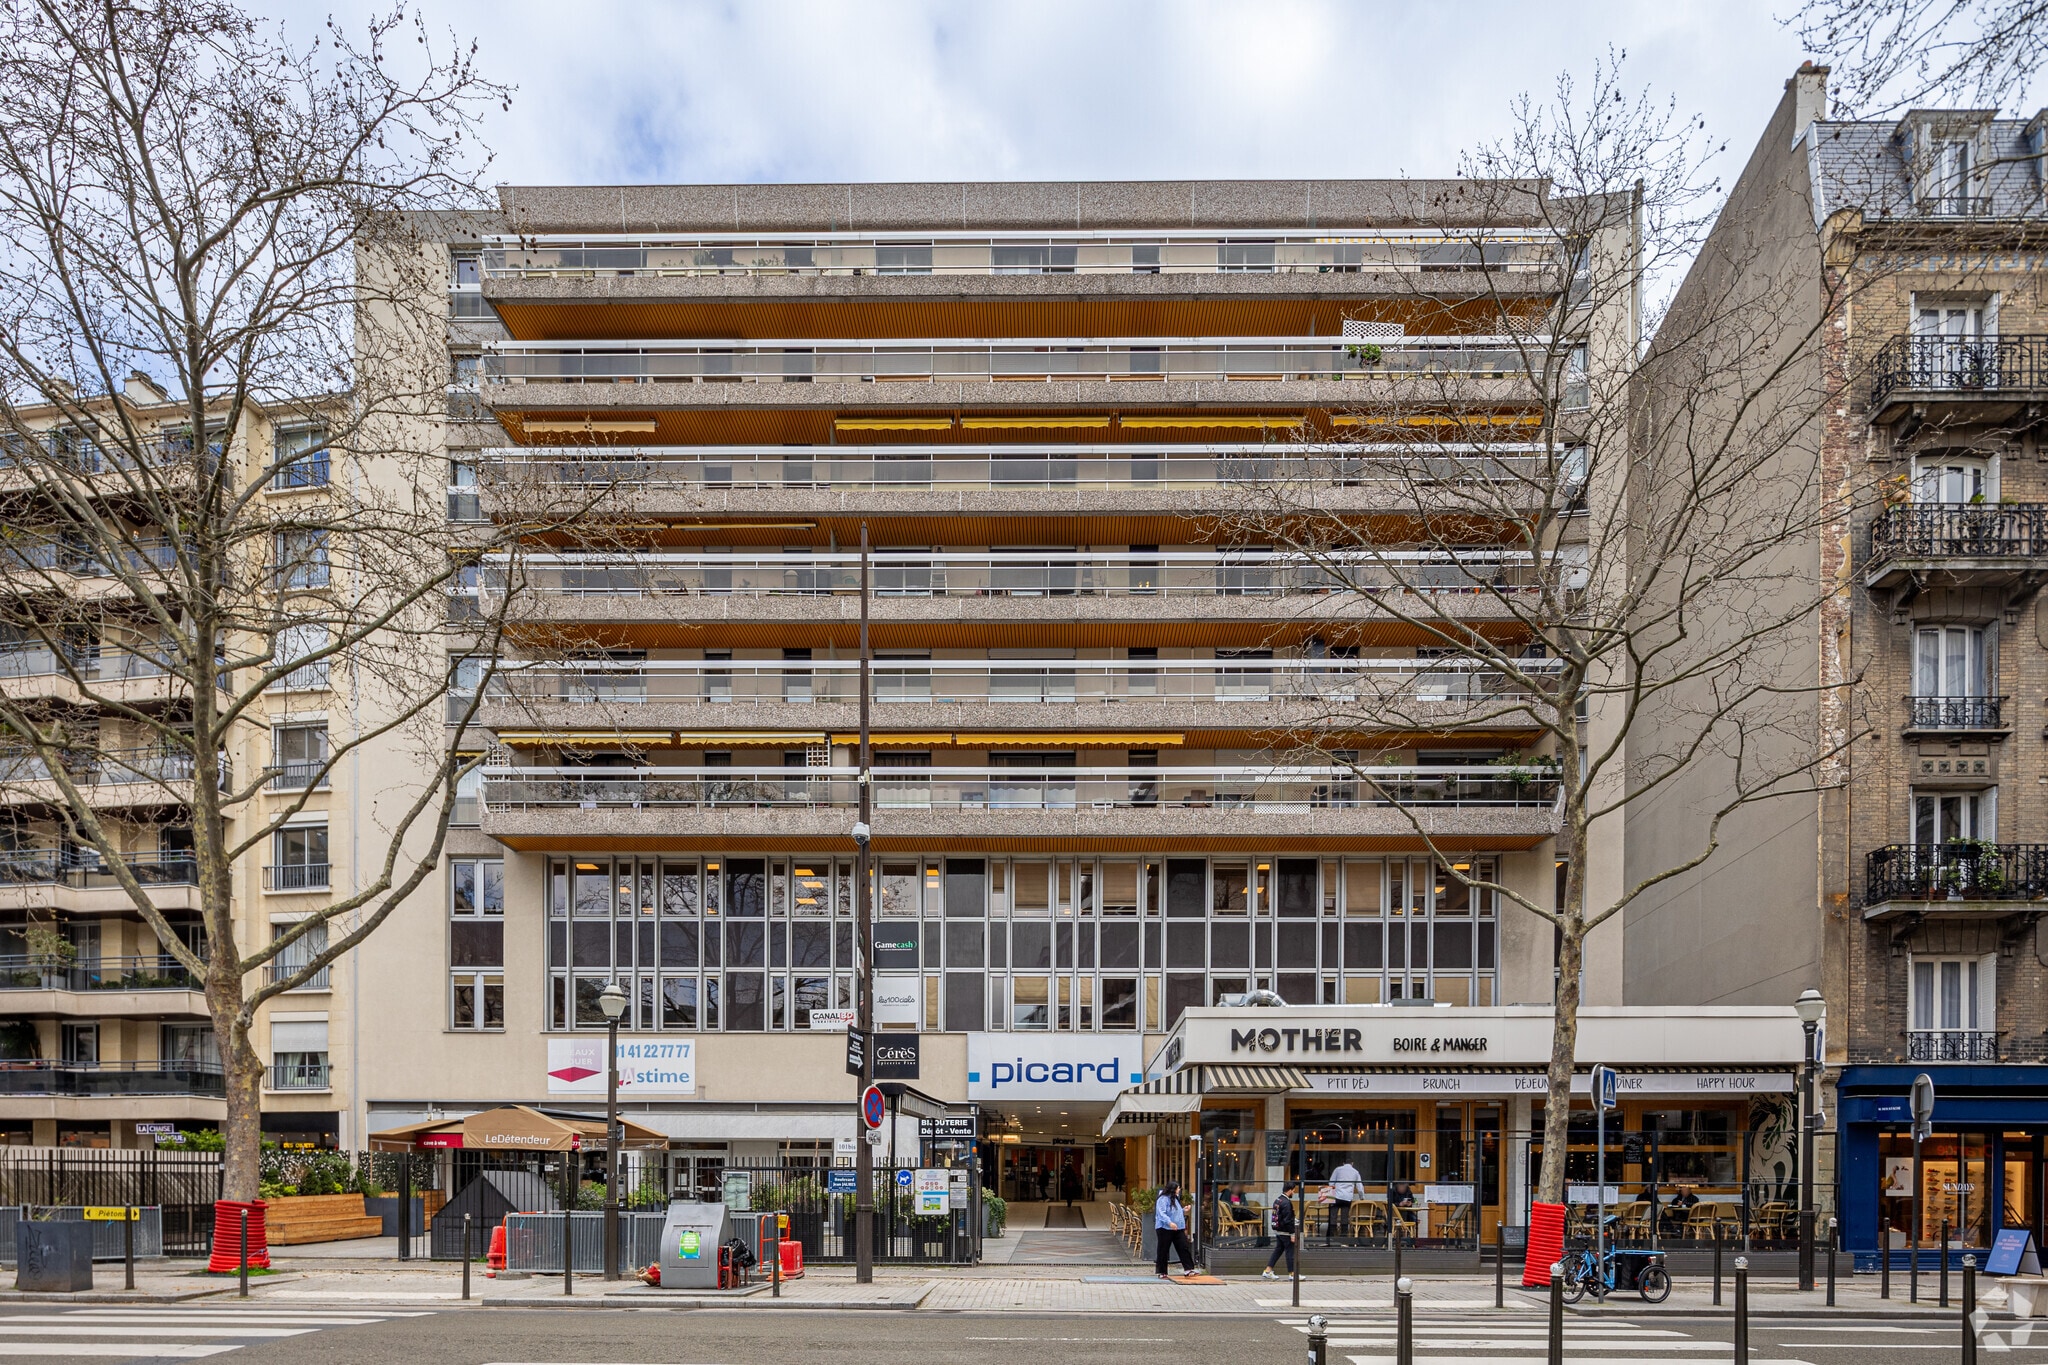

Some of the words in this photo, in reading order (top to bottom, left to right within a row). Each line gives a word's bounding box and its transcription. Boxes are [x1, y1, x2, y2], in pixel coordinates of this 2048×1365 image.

[874, 940, 914, 949] Gamecash
[1231, 1028, 1363, 1051] MOTHER
[1393, 1037, 1428, 1052] BOIRE
[1430, 1037, 1441, 1053] &
[1443, 1037, 1488, 1052] MANGER
[627, 1044, 641, 1058] 41
[643, 1044, 659, 1058] 22
[660, 1044, 675, 1058] 77
[676, 1044, 691, 1058] 77
[991, 1057, 1119, 1089] picard
[1327, 1078, 1348, 1089] P'TIT
[1352, 1076, 1370, 1090] DÉJ
[1422, 1078, 1461, 1090] BRUNCH
[1515, 1076, 1550, 1090] DÉJEUN
[1616, 1076, 1643, 1089] DÎNER
[1696, 1077, 1726, 1089] HAPPY
[1729, 1077, 1756, 1089] HOUR
[921, 1127, 944, 1135] Déôt
[949, 1127, 972, 1135] Vente
[485, 1134, 551, 1146] LeDétendeur
[1942, 1183, 1975, 1191] SUNDAYS
[98, 1209, 126, 1217] Piétons
